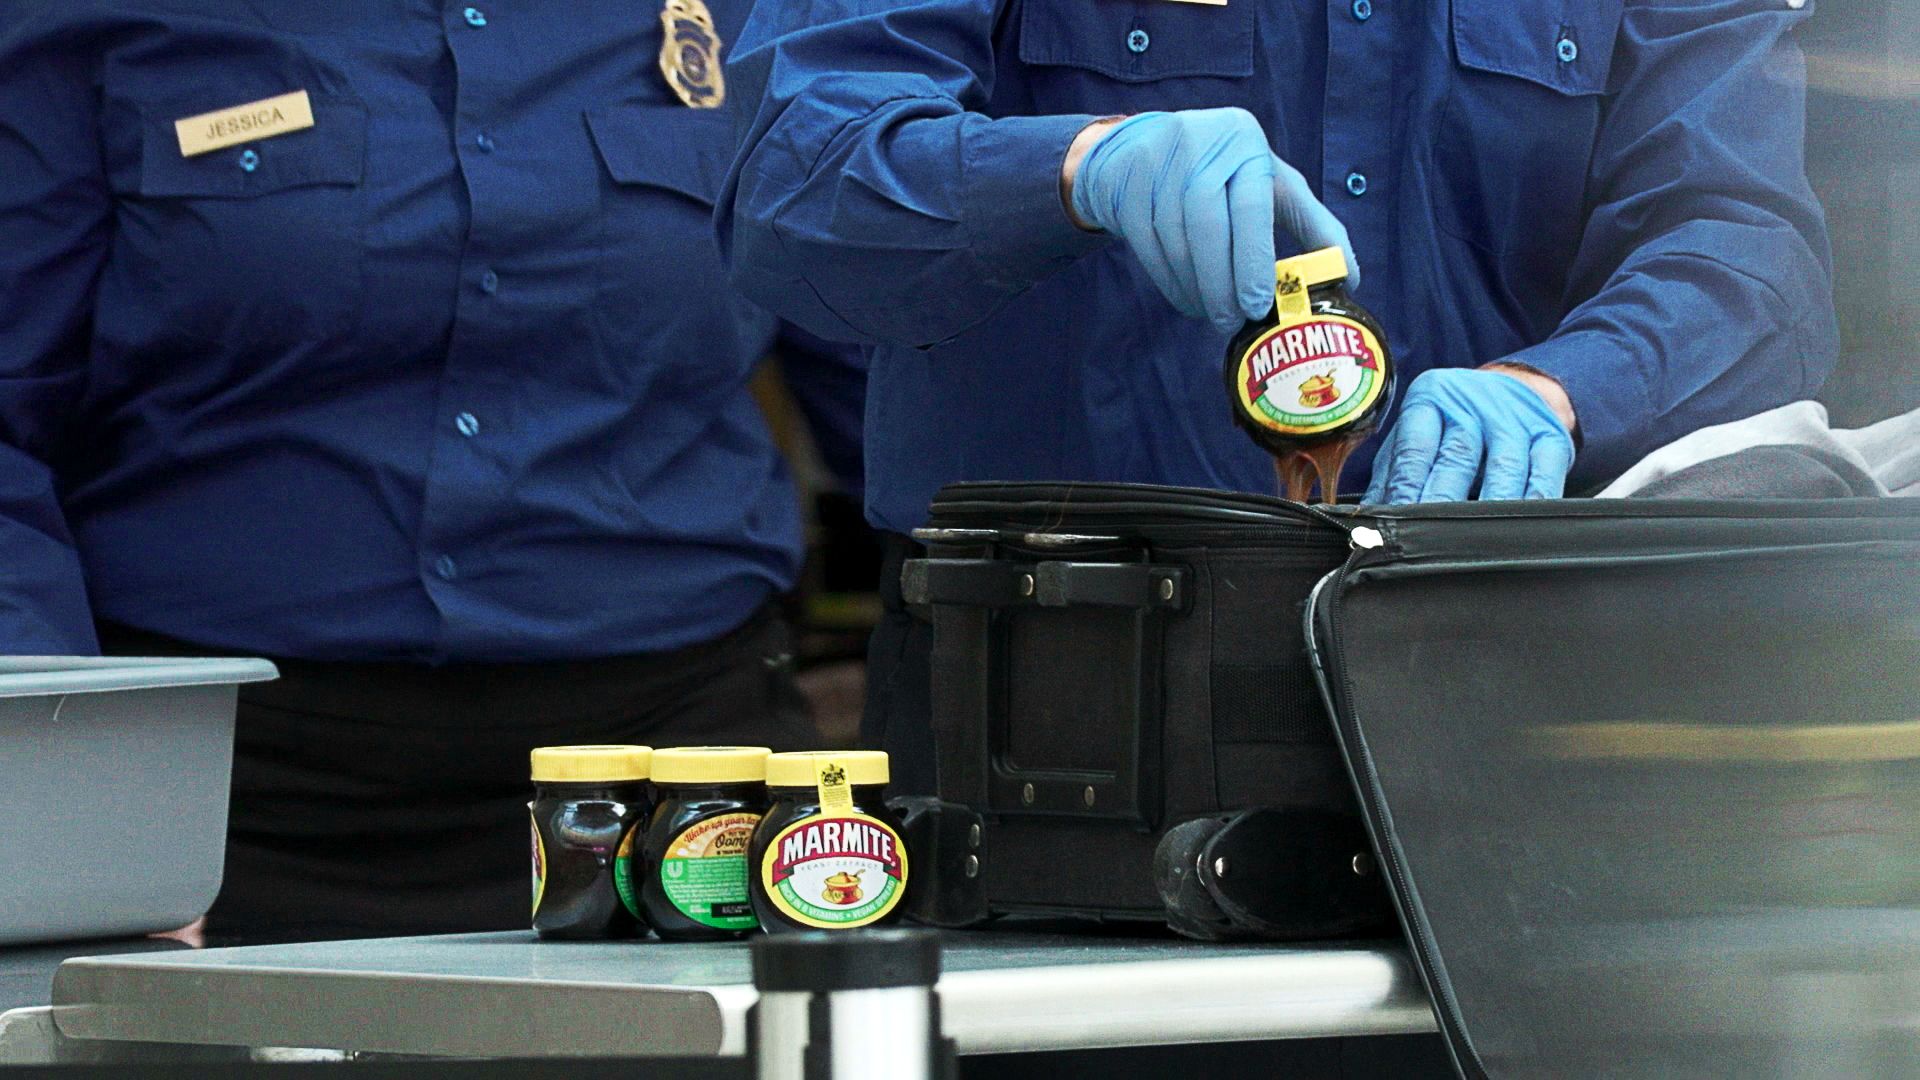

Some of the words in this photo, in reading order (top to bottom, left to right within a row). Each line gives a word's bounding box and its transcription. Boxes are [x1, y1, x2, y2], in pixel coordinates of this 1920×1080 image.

[206, 107, 285, 140] JESSICA
[1252, 324, 1362, 382] MARMITE
[783, 822, 892, 866] MARMITE
